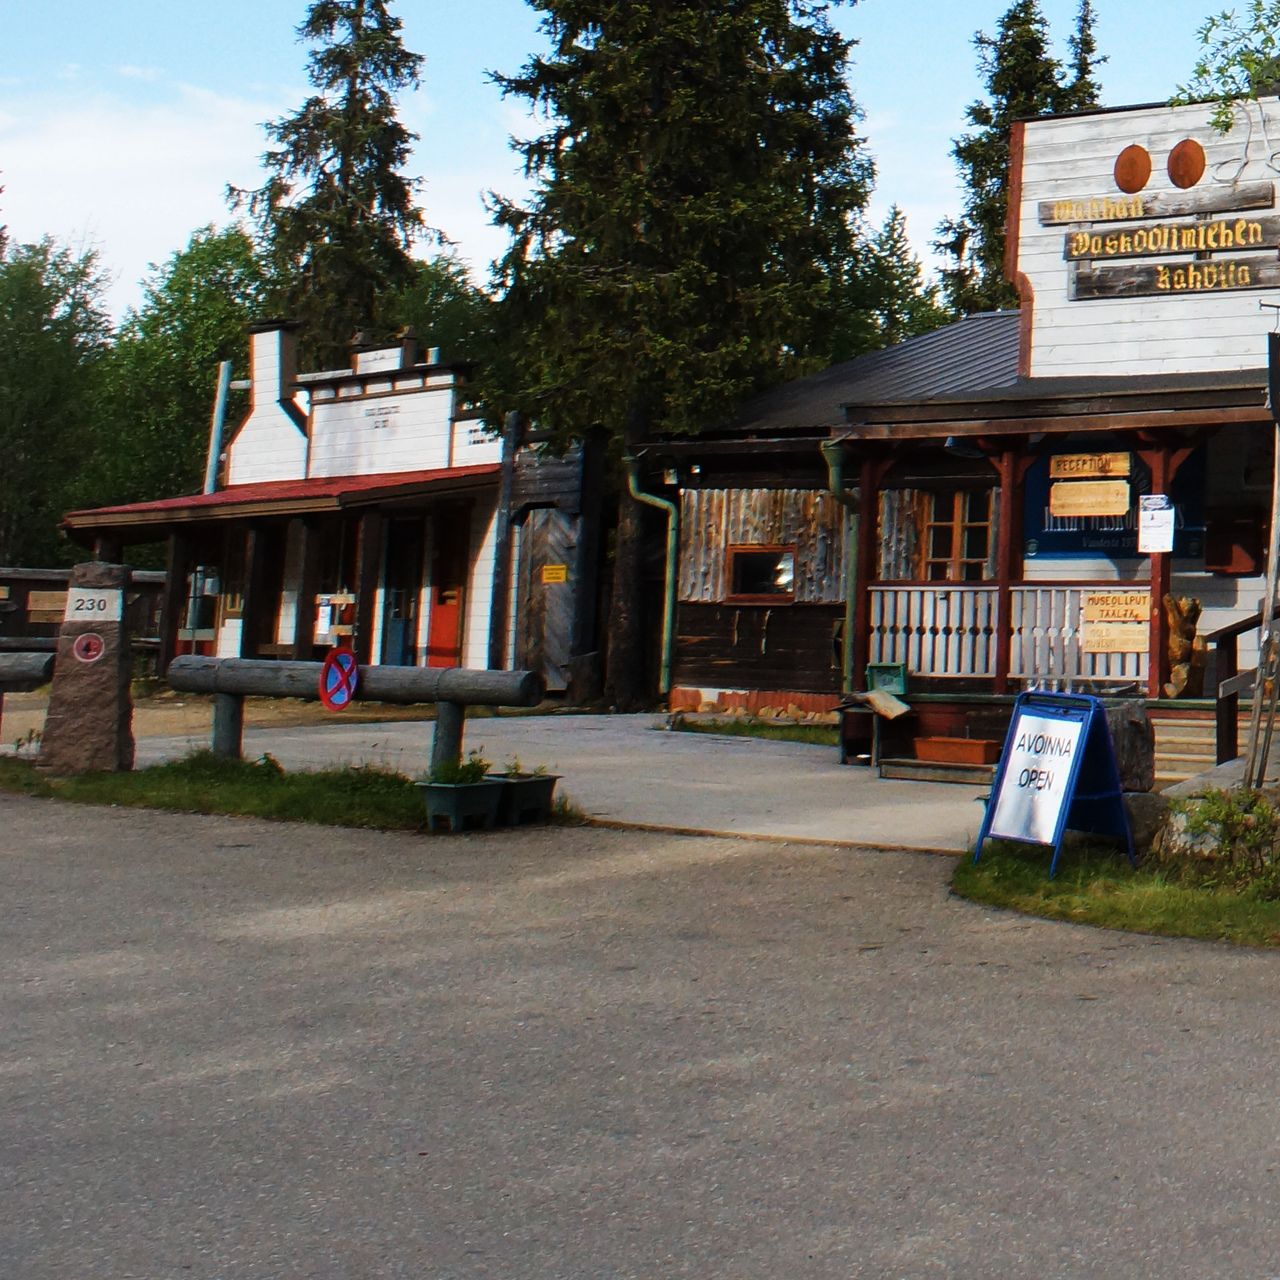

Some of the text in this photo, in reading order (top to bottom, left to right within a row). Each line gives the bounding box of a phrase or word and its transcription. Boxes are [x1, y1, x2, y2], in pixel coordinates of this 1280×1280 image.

[1056, 456, 1112, 471] RECEPTION
[75, 598, 107, 611] 230
[1016, 733, 1072, 757] AVOINNA
[1018, 768, 1055, 791] OPEN
